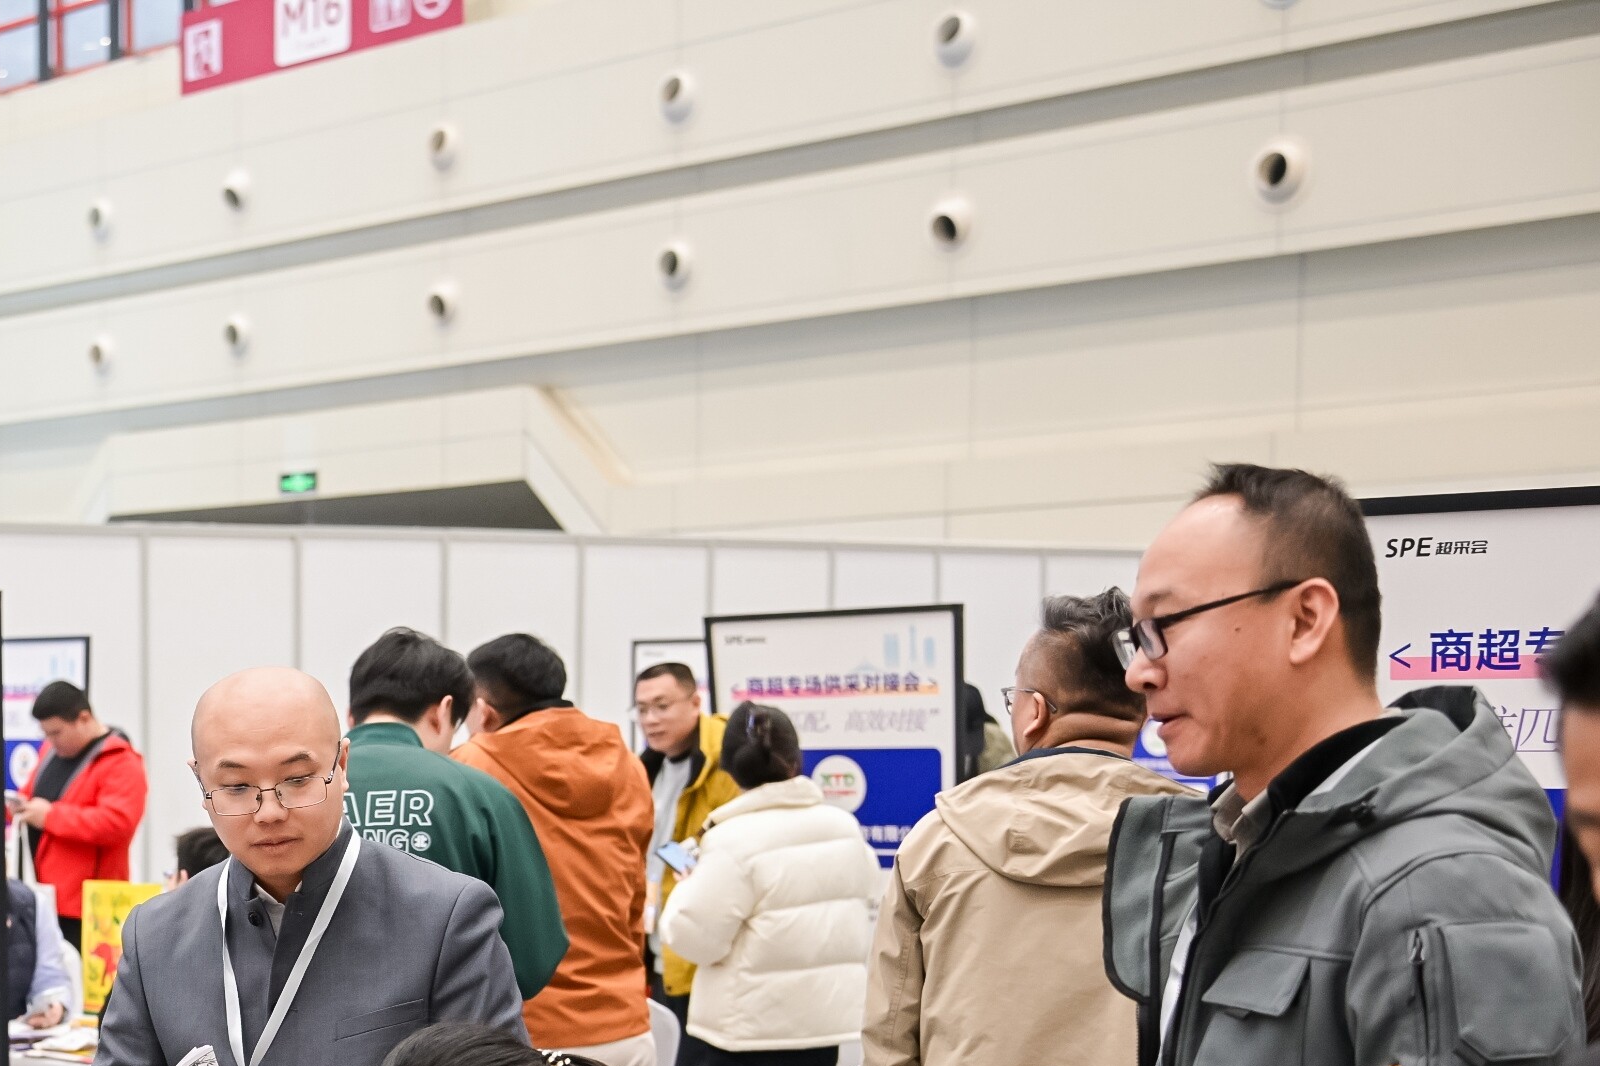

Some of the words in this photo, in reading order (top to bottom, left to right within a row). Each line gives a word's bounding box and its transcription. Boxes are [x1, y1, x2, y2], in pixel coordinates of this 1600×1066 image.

[1385, 536, 1433, 558] SPE
[1435, 540, 1489, 556] 超采会
[746, 671, 921, 695] 商超专场供采对接会
